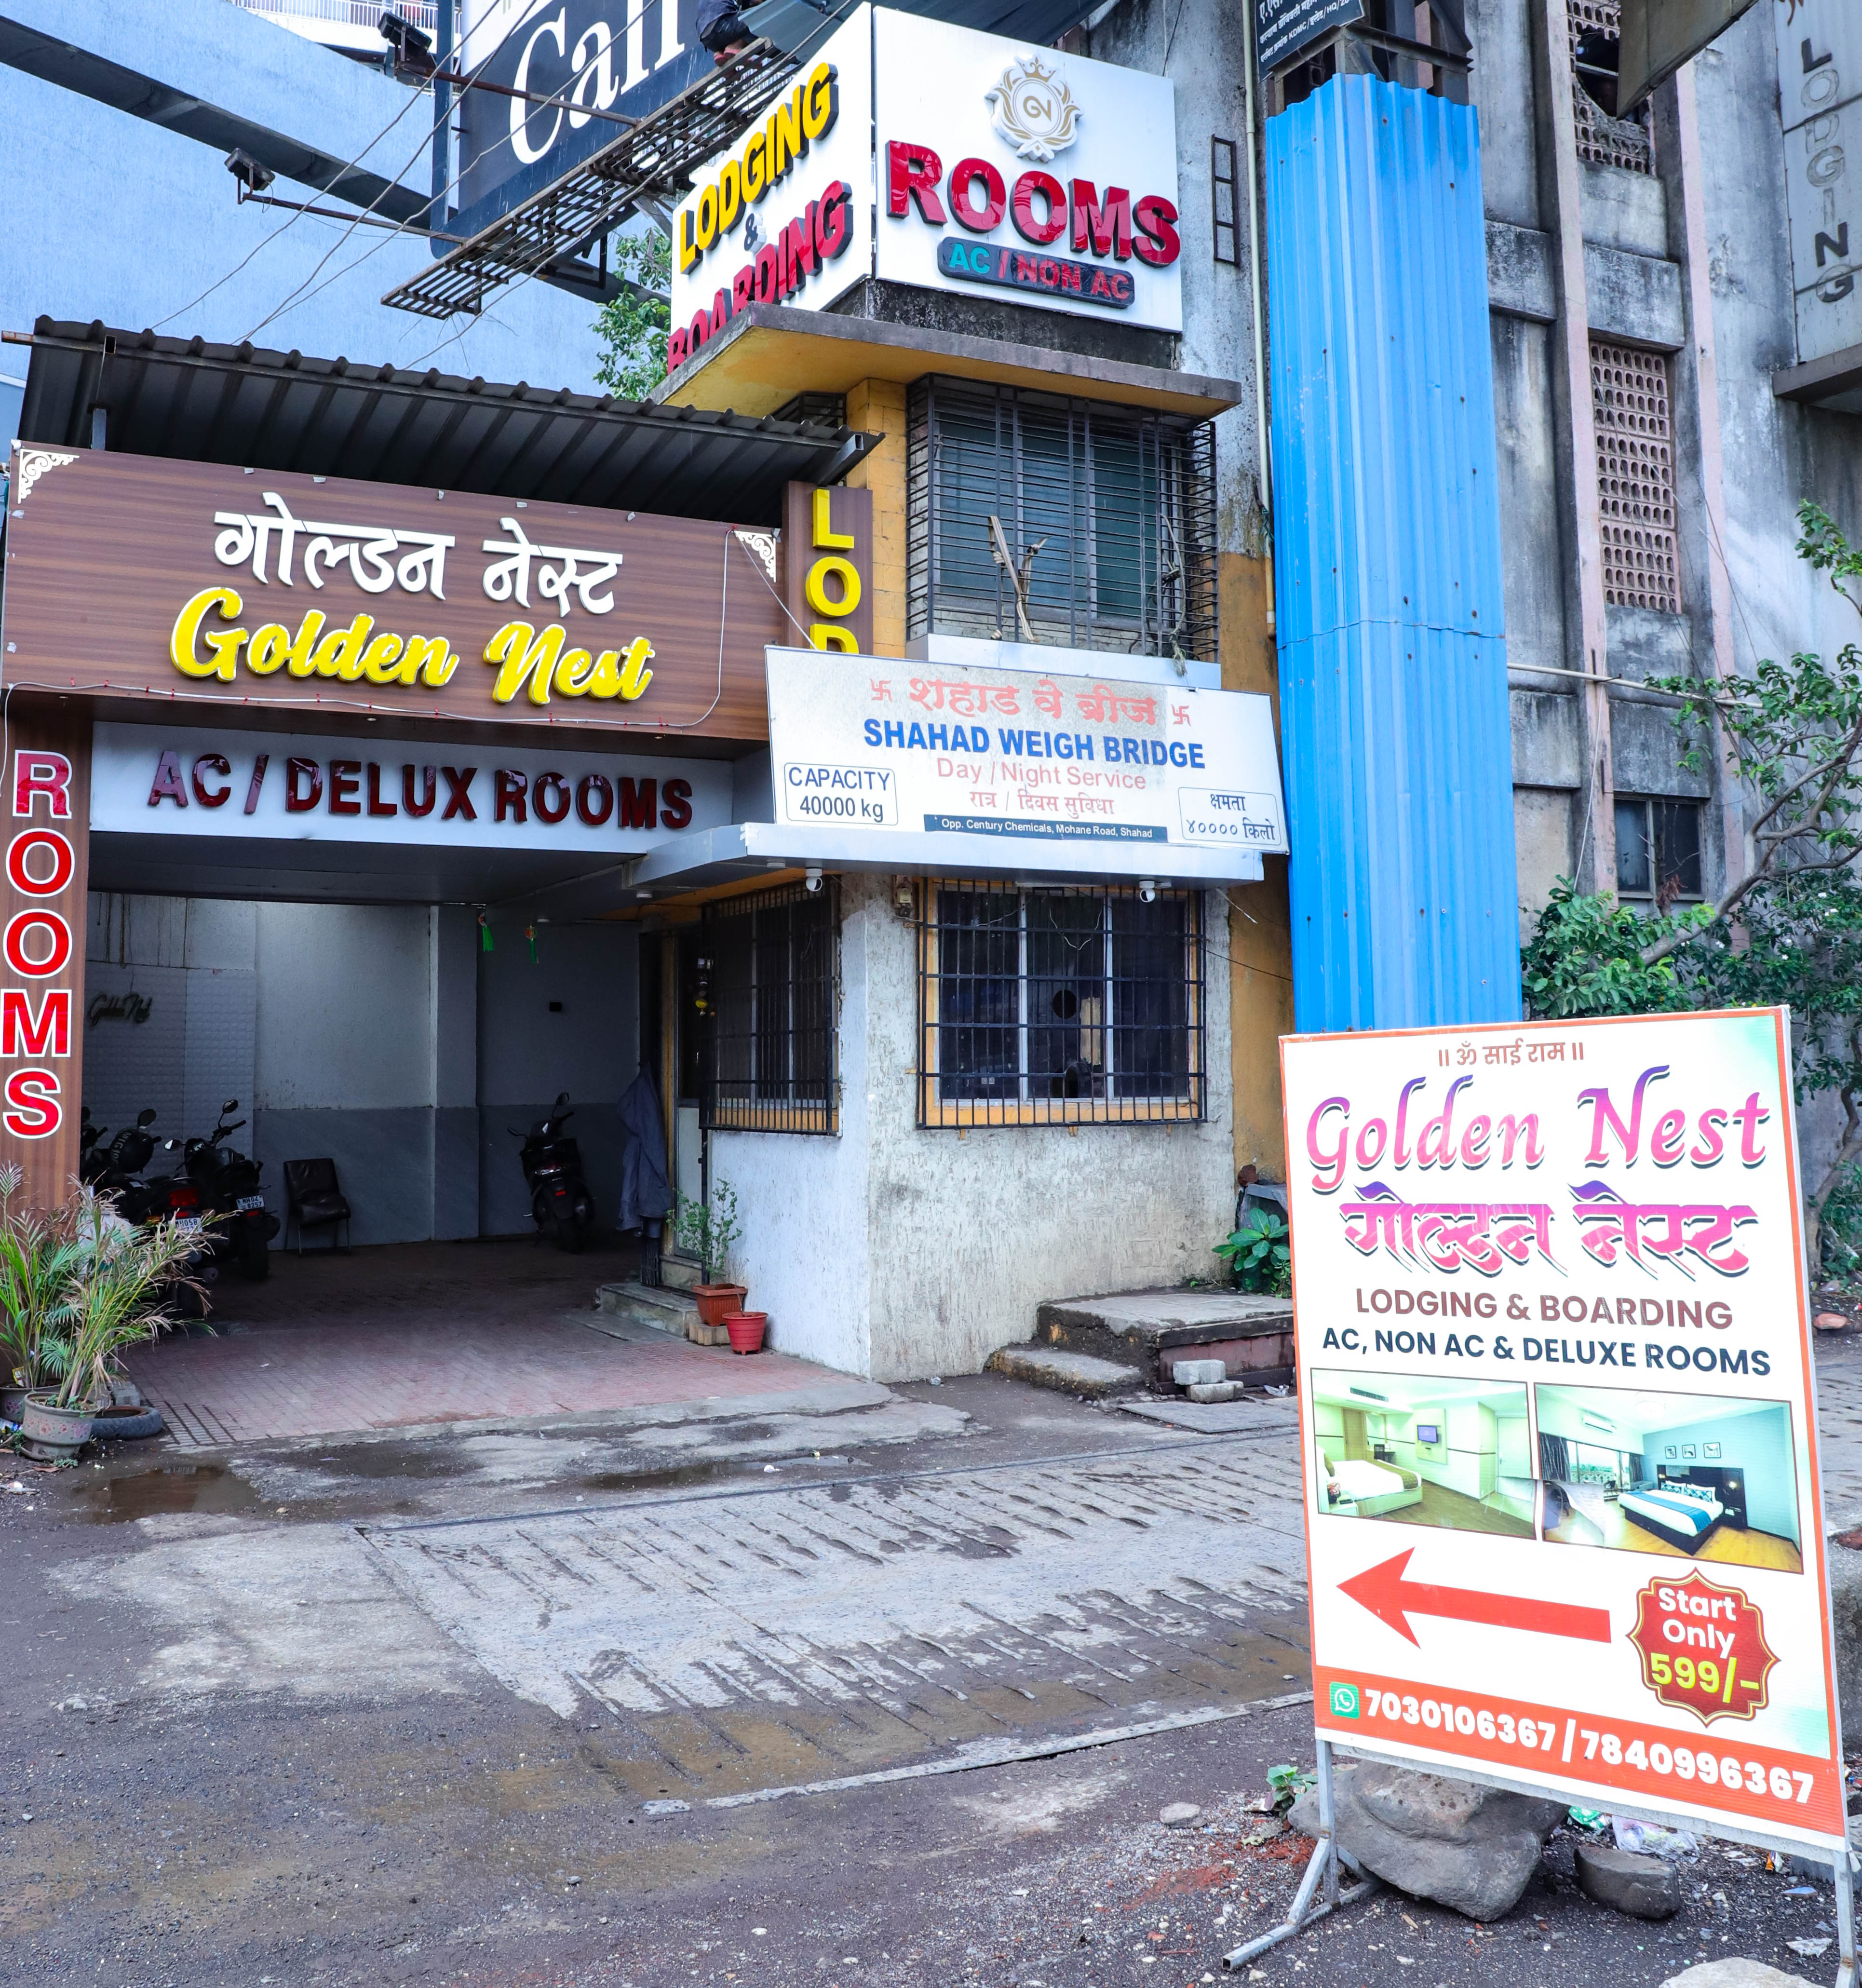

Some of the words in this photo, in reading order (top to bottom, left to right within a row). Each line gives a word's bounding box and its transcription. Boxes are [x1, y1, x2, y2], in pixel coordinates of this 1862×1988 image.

[680, 62, 838, 274] LODGING
[1801, 38, 1854, 304] LODGING
[886, 140, 1180, 268] ROOMS
[744, 213, 767, 253] &
[667, 180, 853, 375] BOARDING
[949, 243, 990, 274] AC
[1017, 254, 1081, 291] NON
[1090, 271, 1129, 299] AC
[214, 492, 455, 600] गोल्डन
[483, 517, 622, 617] नेस्ट
[170, 587, 459, 687] Golden
[483, 621, 655, 706] Nest
[909, 678, 1020, 717] शहाड
[1032, 679, 1063, 719] वे
[864, 718, 989, 753] SHAHAD
[998, 729, 1094, 760] WEIGH
[1103, 736, 1205, 769] BRIDGE
[147, 750, 231, 808] AC
[285, 757, 477, 820] DELUX
[494, 769, 693, 829] ROOMS
[788, 767, 890, 791] CAPACITY
[937, 757, 982, 784] Day
[1001, 762, 1061, 787] Night
[1067, 766, 1146, 789] Service
[800, 796, 855, 816] 40000
[862, 798, 883, 822] kg
[1017, 788, 1059, 811] दिवस
[1065, 792, 1114, 819] सुविधा
[1211, 794, 1246, 811] क्षमता
[942, 818, 963, 829] Opp.
[966, 820, 1002, 832] Century
[1005, 822, 1054, 834] Chemicals,
[1056, 825, 1091, 835] Mohane
[1093, 826, 1118, 837] Road,
[1120, 828, 1152, 838] Shahad
[1242, 817, 1275, 840] किलो
[0, 749, 75, 1139] ROOMS
[1482, 1038, 1524, 1065] साई
[1526, 1042, 1565, 1062] राम
[1306, 1075, 1544, 1195] Golden
[1577, 1064, 1770, 1170] Nest
[1339, 1180, 1567, 1278] गोल्डन
[1568, 1180, 1758, 1281] नेस्ट
[1357, 1288, 1497, 1318] LODGING
[1507, 1294, 1531, 1320] &
[1540, 1295, 1732, 1329] BOARDING
[1322, 1327, 1367, 1354] AC,
[1375, 1330, 1436, 1354] NON
[1444, 1334, 1484, 1357] AC
[1493, 1336, 1515, 1359] &
[1523, 1338, 1636, 1367] DELUXE
[1645, 1344, 1770, 1376] ROOMS
[1659, 1587, 1736, 1621] Start
[1662, 1619, 1735, 1659] Only
[1651, 1652, 1759, 1704] 599/-
